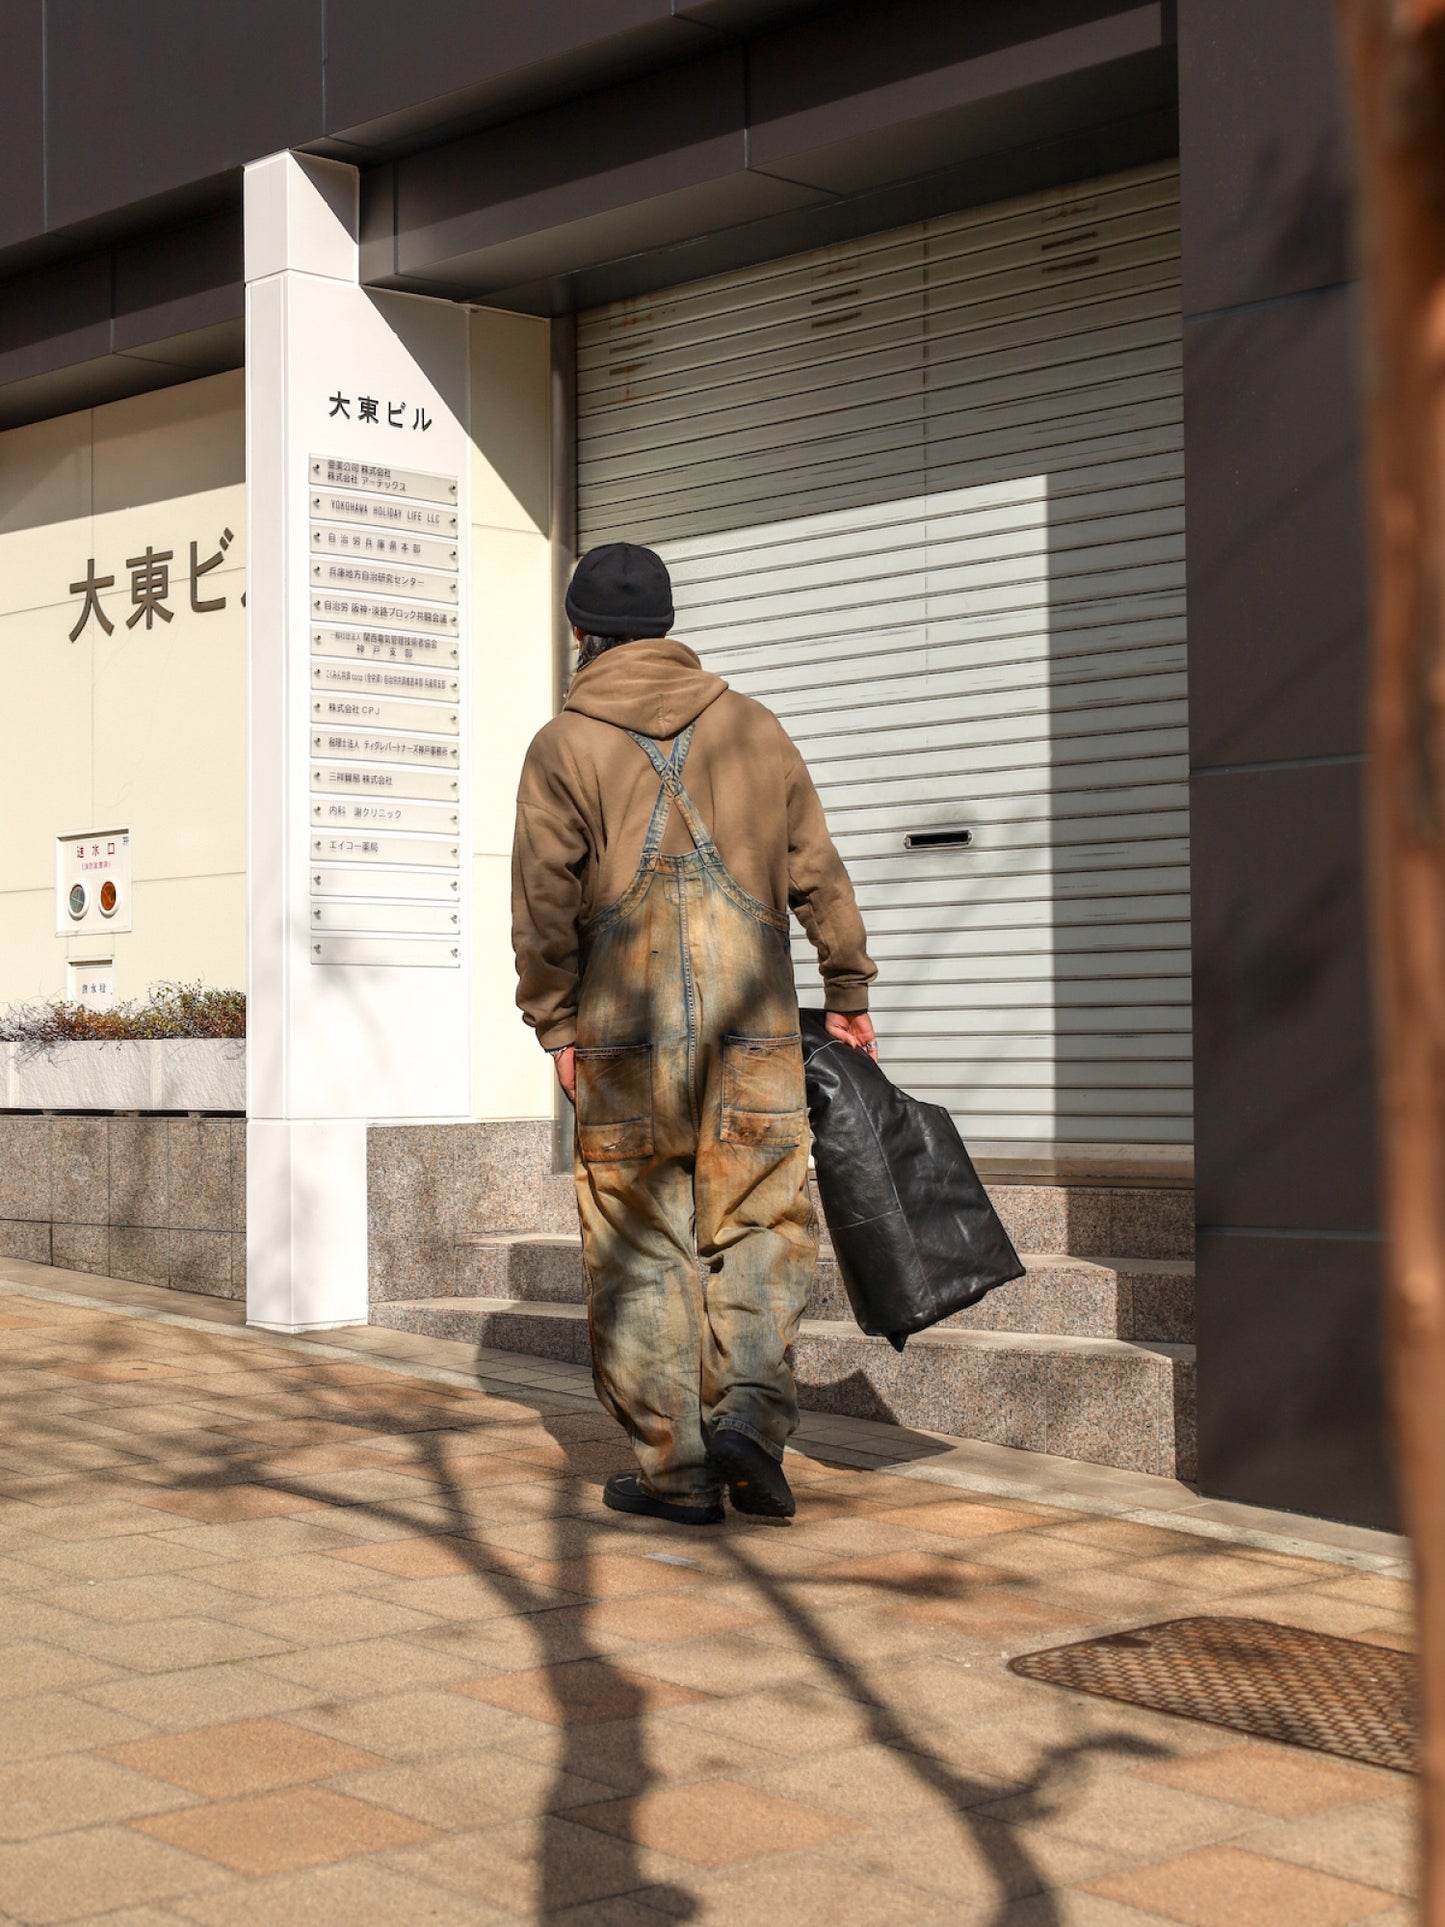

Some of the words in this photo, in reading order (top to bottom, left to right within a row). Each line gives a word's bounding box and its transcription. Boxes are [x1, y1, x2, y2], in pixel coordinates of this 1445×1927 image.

[329, 391, 433, 432] 大東ビル
[361, 465, 391, 479] 株式会社
[327, 471, 358, 485] 株式会社
[362, 477, 406, 492] アーテックス
[331, 499, 368, 513] YOKOHAMA
[373, 505, 403, 520] HOLIDAY
[407, 510, 422, 521] LIFE
[427, 512, 440, 524] LLC
[69, 527, 247, 643] 大東ビ
[329, 702, 359, 715] 株式会社
[329, 737, 360, 750] 税理士法人
[362, 774, 393, 786] 株式会社
[329, 805, 346, 817] 内科
[76, 842, 116, 859] 送水口
[329, 840, 378, 854] エイコー薬局
